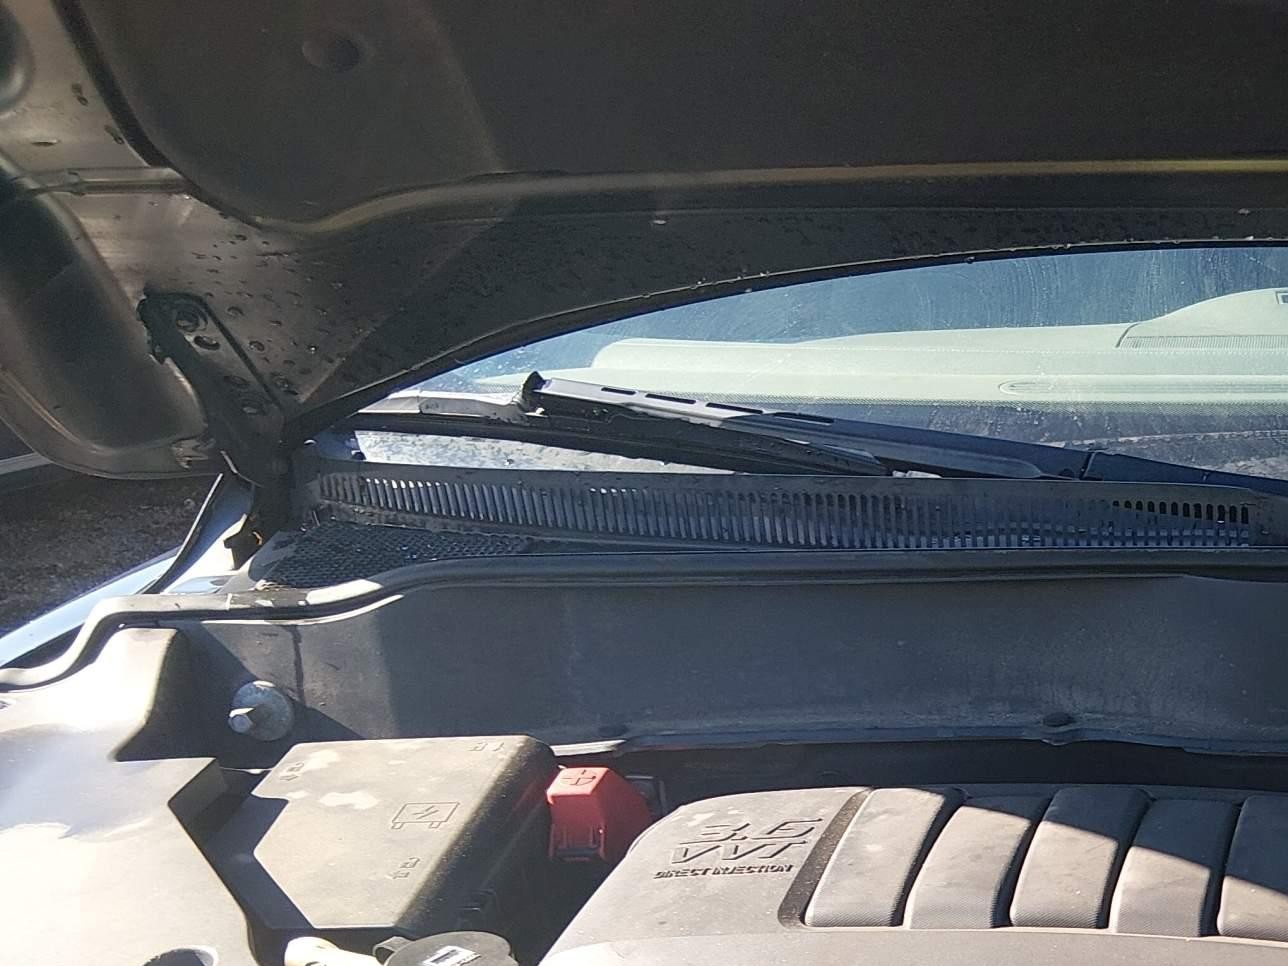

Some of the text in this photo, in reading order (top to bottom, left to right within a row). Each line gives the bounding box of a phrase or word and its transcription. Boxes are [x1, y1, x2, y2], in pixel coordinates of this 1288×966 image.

[679, 817, 824, 845] 3.6
[671, 839, 808, 865] VVT
[653, 863, 795, 880] DIRECT INJECTION
